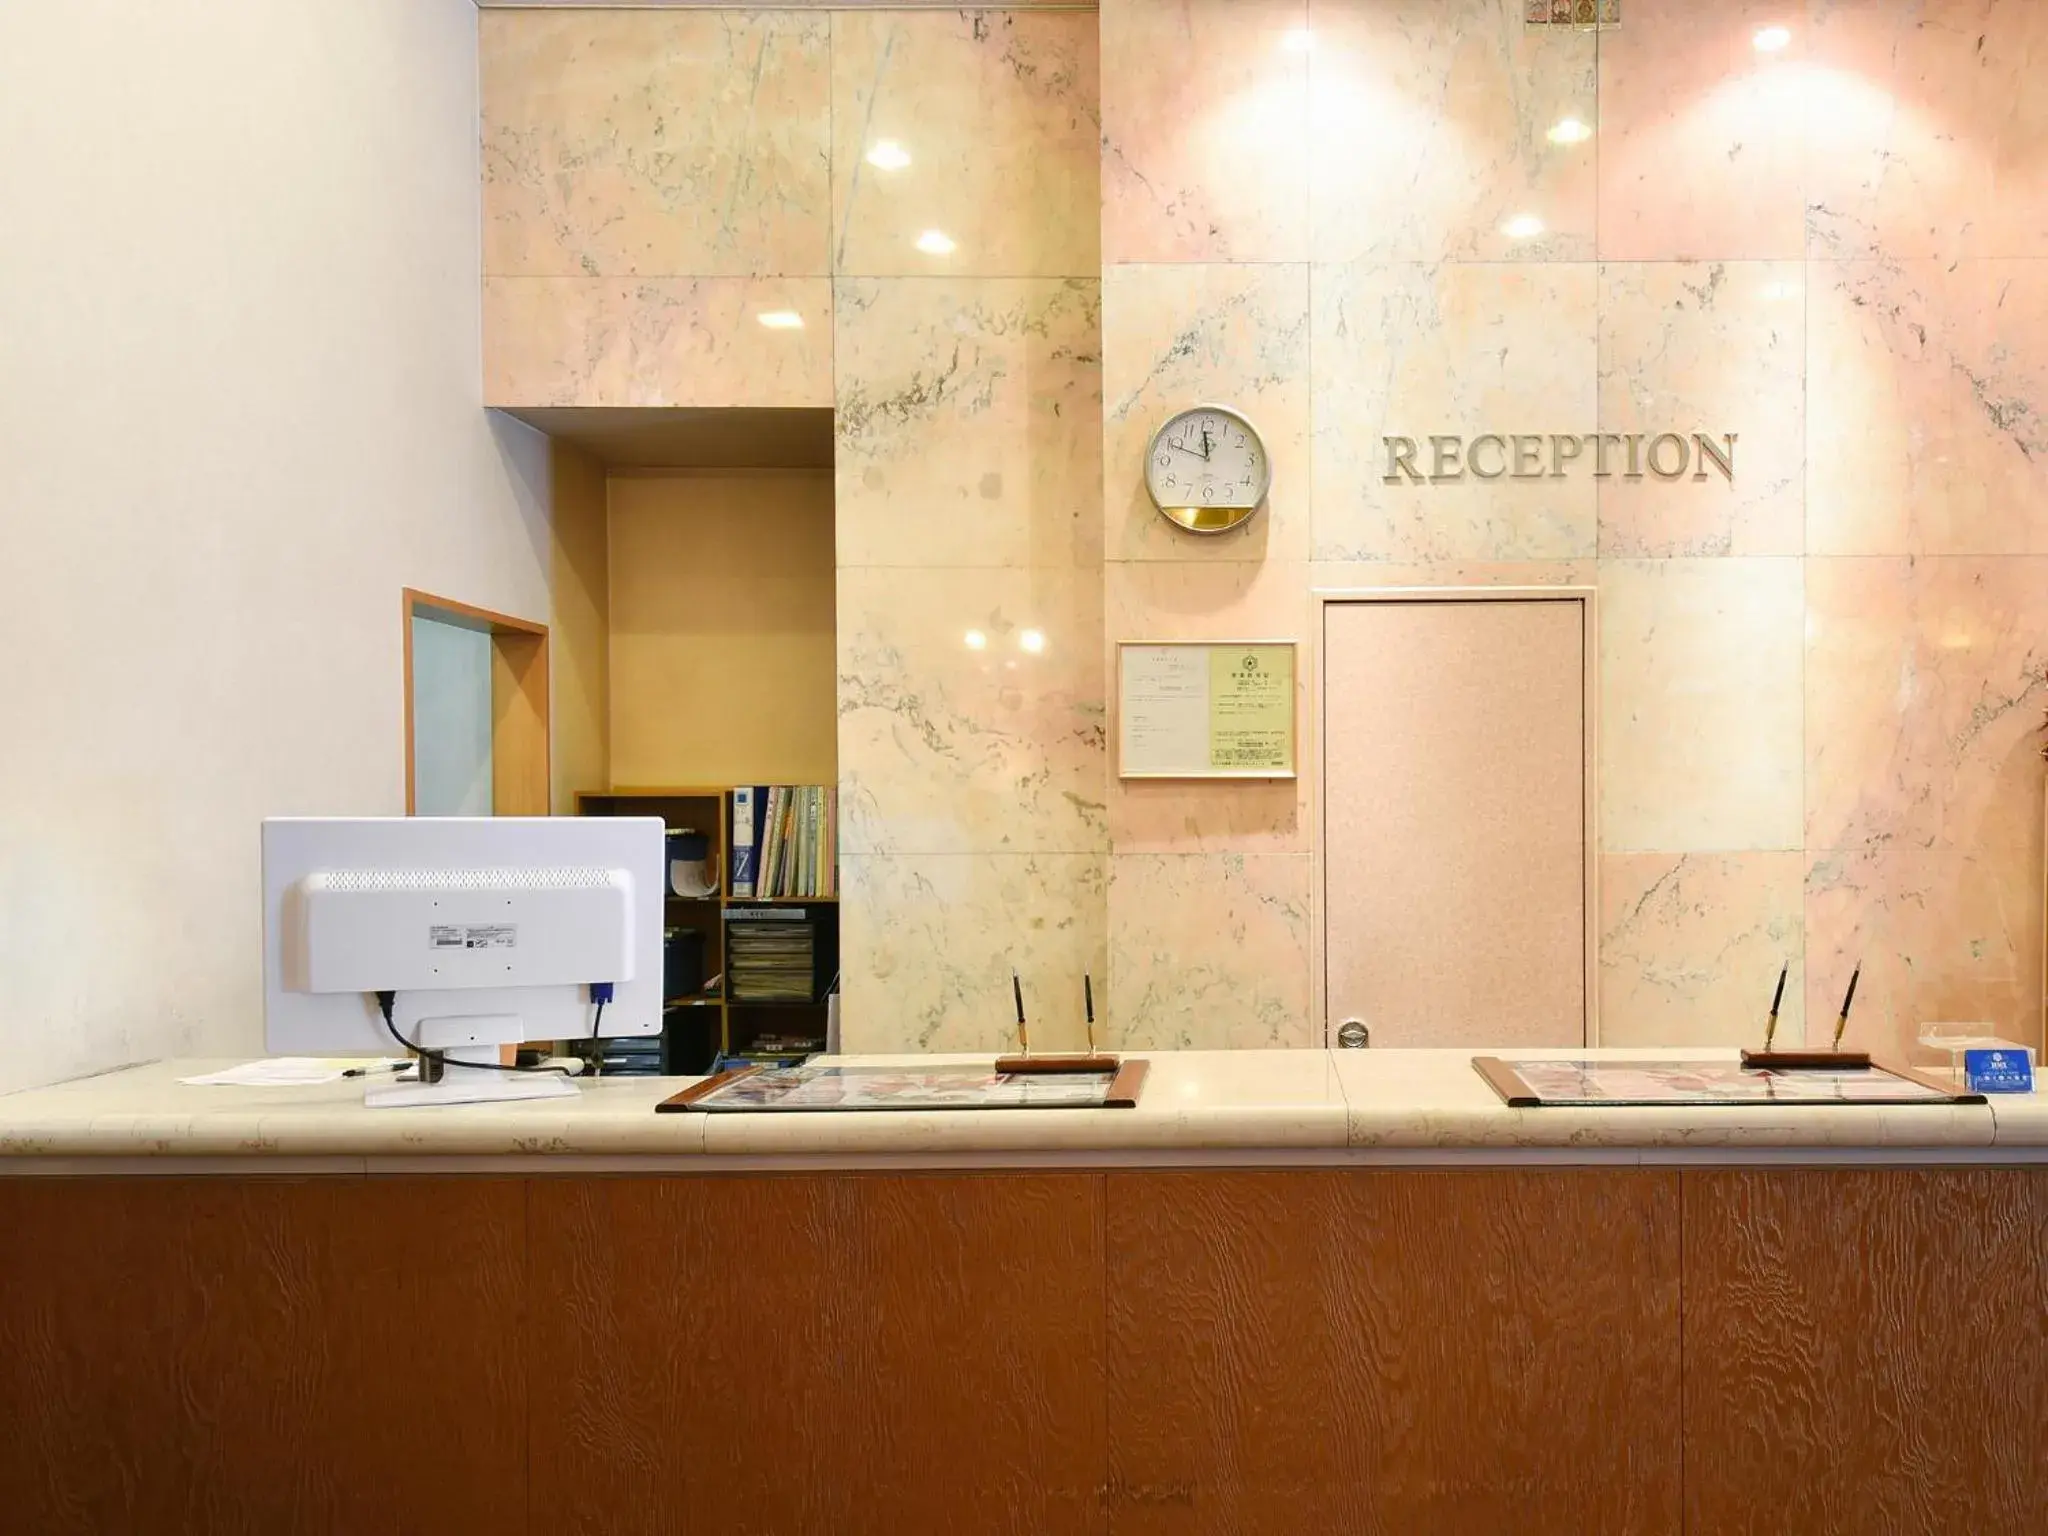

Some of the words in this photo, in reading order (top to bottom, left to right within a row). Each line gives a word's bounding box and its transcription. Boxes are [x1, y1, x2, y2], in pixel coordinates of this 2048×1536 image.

[1184, 422, 1194, 438] 11
[1235, 434, 1246, 448] 2
[1382, 432, 1739, 484] RECEPTION
[1166, 473, 1176, 488] 8
[1184, 483, 1193, 500] 7
[1203, 481, 1213, 498] 6
[1225, 483, 1234, 498] 5
